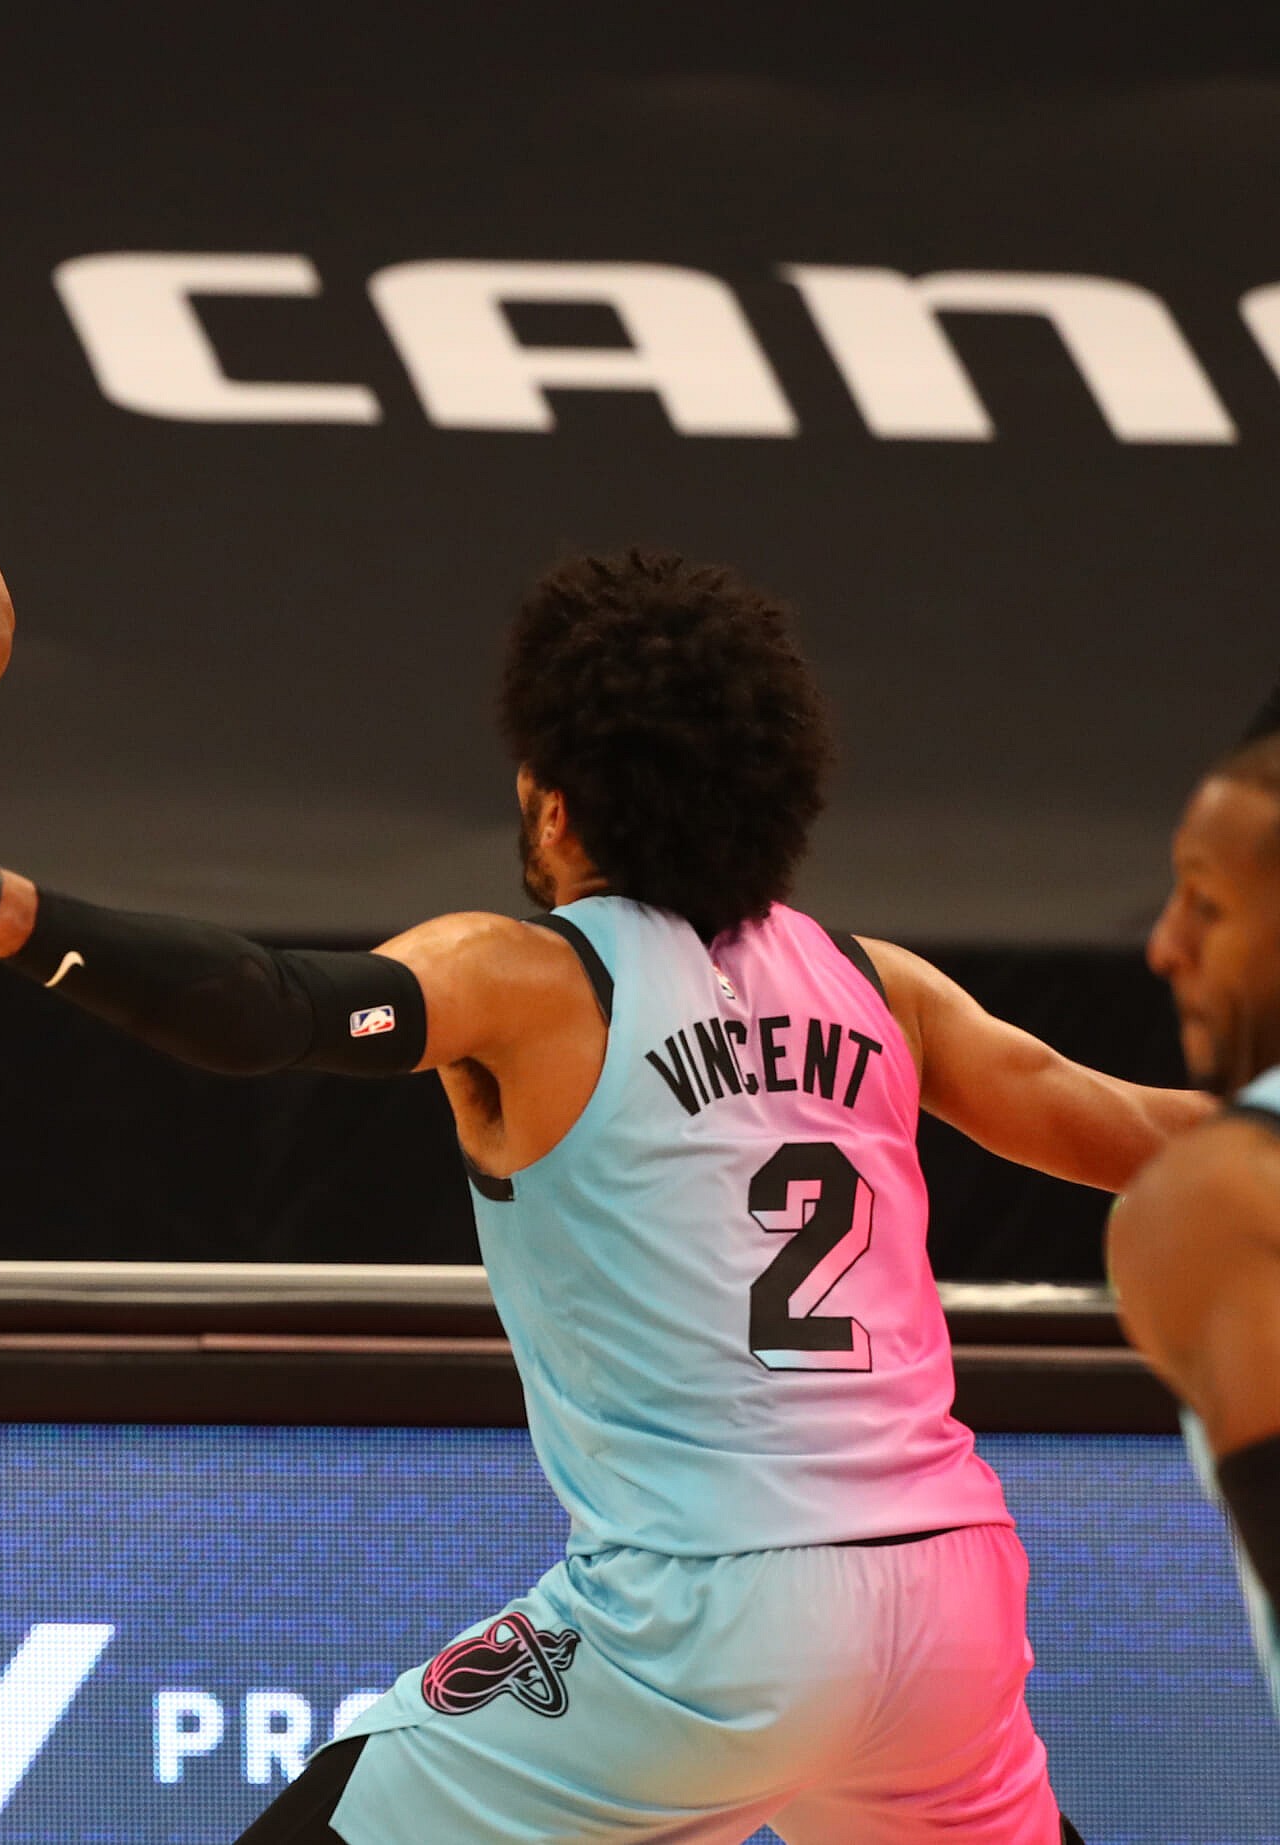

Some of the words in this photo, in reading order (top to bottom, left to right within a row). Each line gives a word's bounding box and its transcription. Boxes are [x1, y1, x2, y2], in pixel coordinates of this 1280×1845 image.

[53, 252, 1280, 446] CAN
[644, 1015, 883, 1117] VINCENT
[747, 1141, 875, 1374] 2
